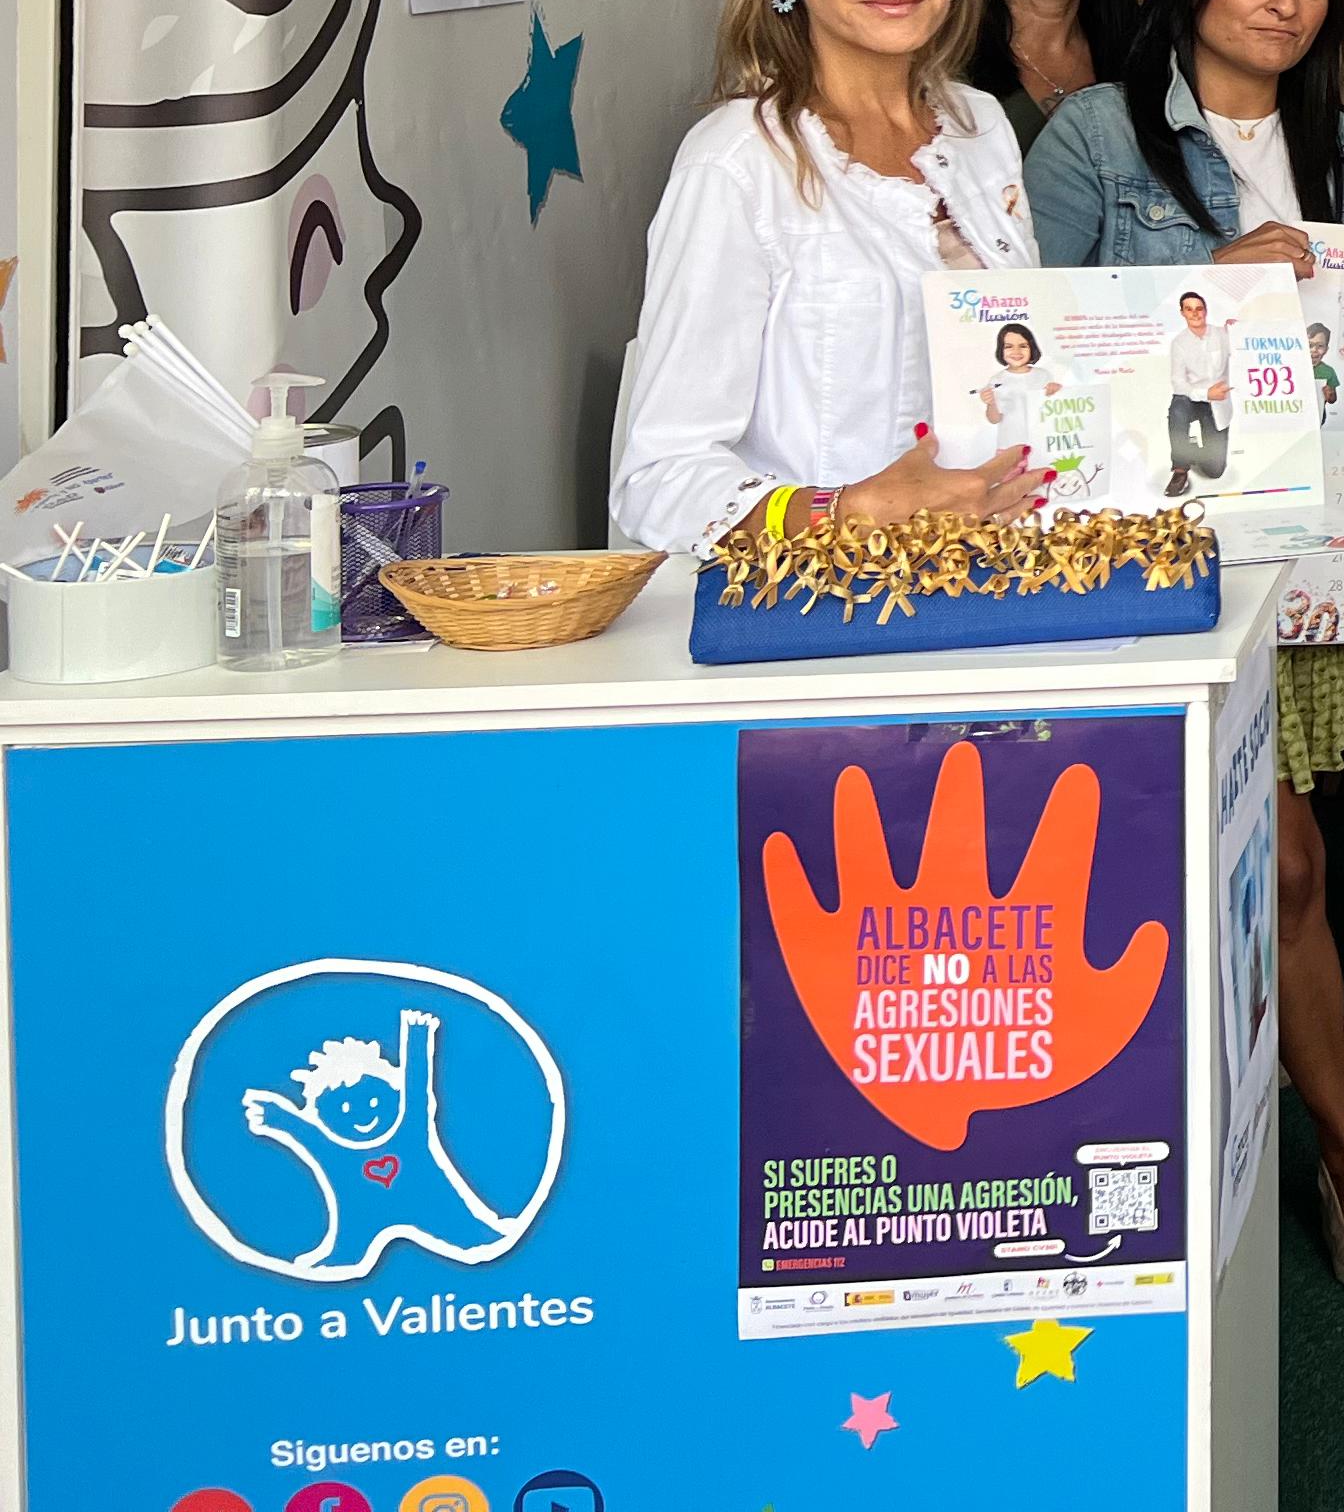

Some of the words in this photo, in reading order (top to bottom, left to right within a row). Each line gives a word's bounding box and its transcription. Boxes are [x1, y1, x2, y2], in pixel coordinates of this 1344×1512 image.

[978, 309, 1029, 324] Ilusión
[981, 293, 1029, 308] Añazos
[1258, 352, 1282, 366] POR
[1247, 366, 1295, 398] 593
[1243, 399, 1303, 415] FAMILIAS!
[1054, 417, 1084, 434] UNA
[856, 904, 1054, 951] ALBACETE
[857, 955, 910, 986] DICE
[922, 952, 970, 986] NO
[981, 954, 998, 984] A
[1008, 953, 1053, 984] LAS
[853, 988, 1054, 1031] AGRESIONES
[851, 1030, 1054, 1085] SEXUALES
[763, 1160, 788, 1187] SI
[790, 1156, 872, 1187] SUFRES
[875, 1154, 896, 1184] O
[764, 1186, 901, 1219] PRESENCIAS
[907, 1183, 955, 1212] UNA
[961, 1172, 1079, 1209] AGRESIÓN,
[763, 1220, 838, 1250] ACUDE
[843, 1218, 871, 1247] AL
[875, 1212, 950, 1245] PUNTO
[956, 1207, 1047, 1241] VIOLETA
[775, 1257, 831, 1271] EMERGENCIAS
[832, 1256, 845, 1268] 112
[166, 1307, 302, 1347] Junto
[320, 1311, 348, 1338] a
[362, 1292, 595, 1336] Valientes
[444, 1434, 501, 1459] en:
